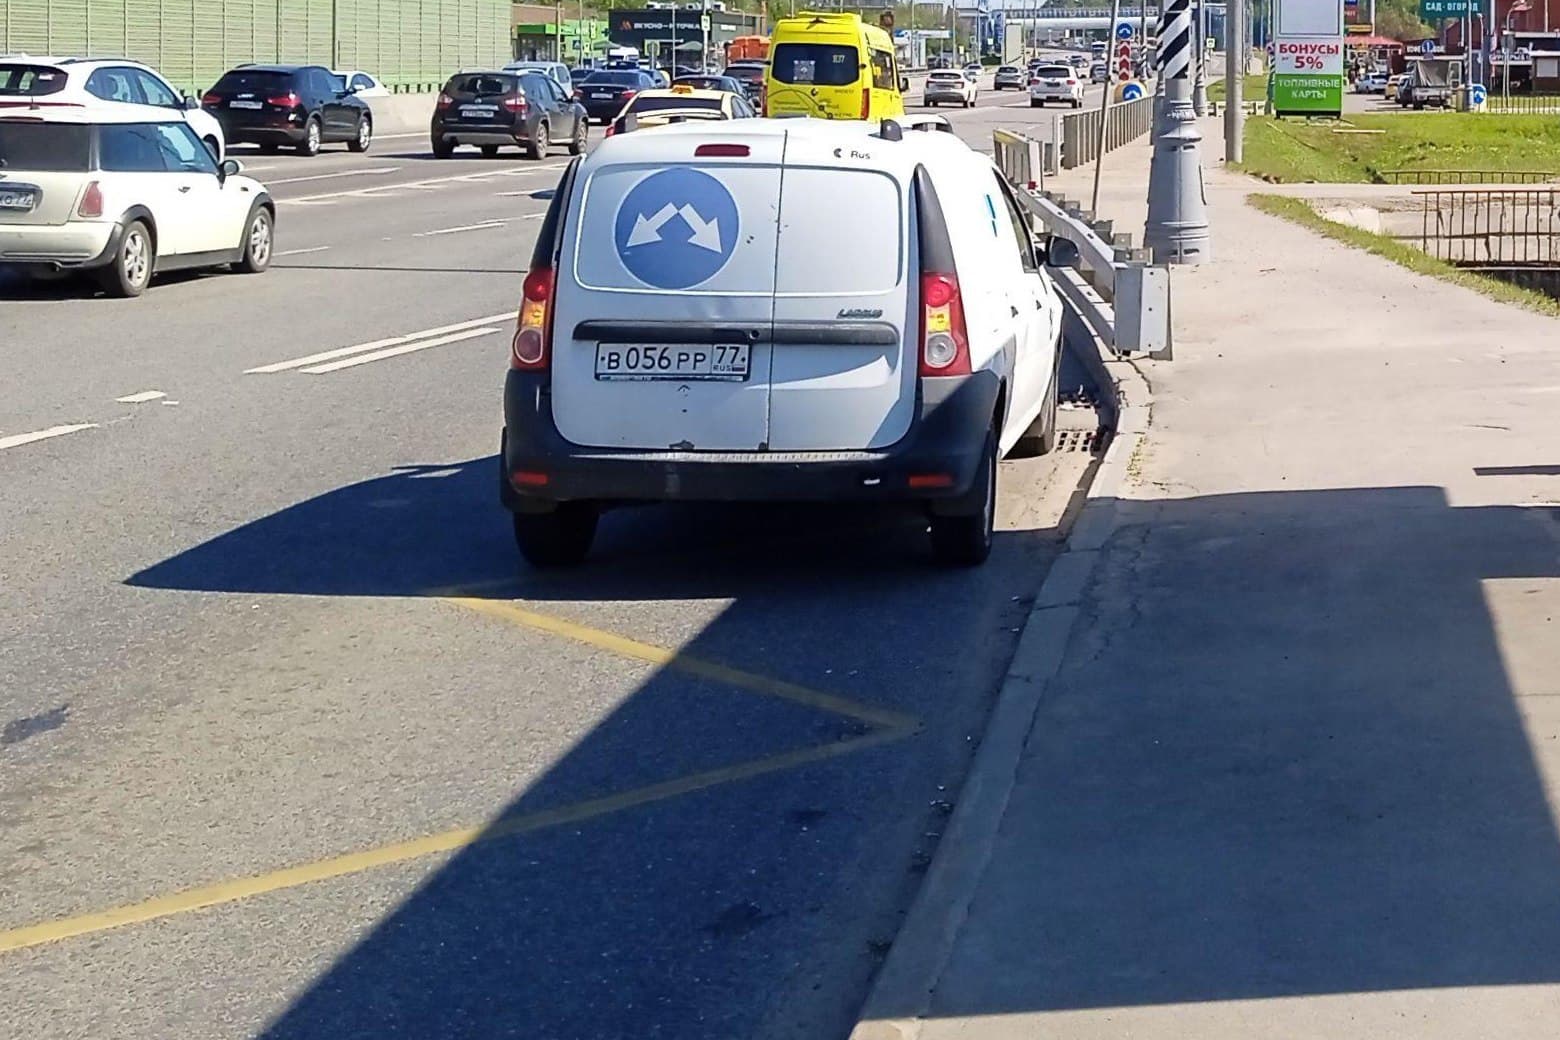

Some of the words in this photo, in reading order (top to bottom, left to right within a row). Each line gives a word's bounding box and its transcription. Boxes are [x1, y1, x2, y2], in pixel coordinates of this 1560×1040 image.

[1279, 44, 1339, 55] БОНУСЫ
[1294, 56, 1324, 69] 5%
[1279, 79, 1341, 88] ТОПЛИВНЫЕ
[1292, 90, 1327, 99] КАРТЫ
[716, 346, 740, 364] 77
